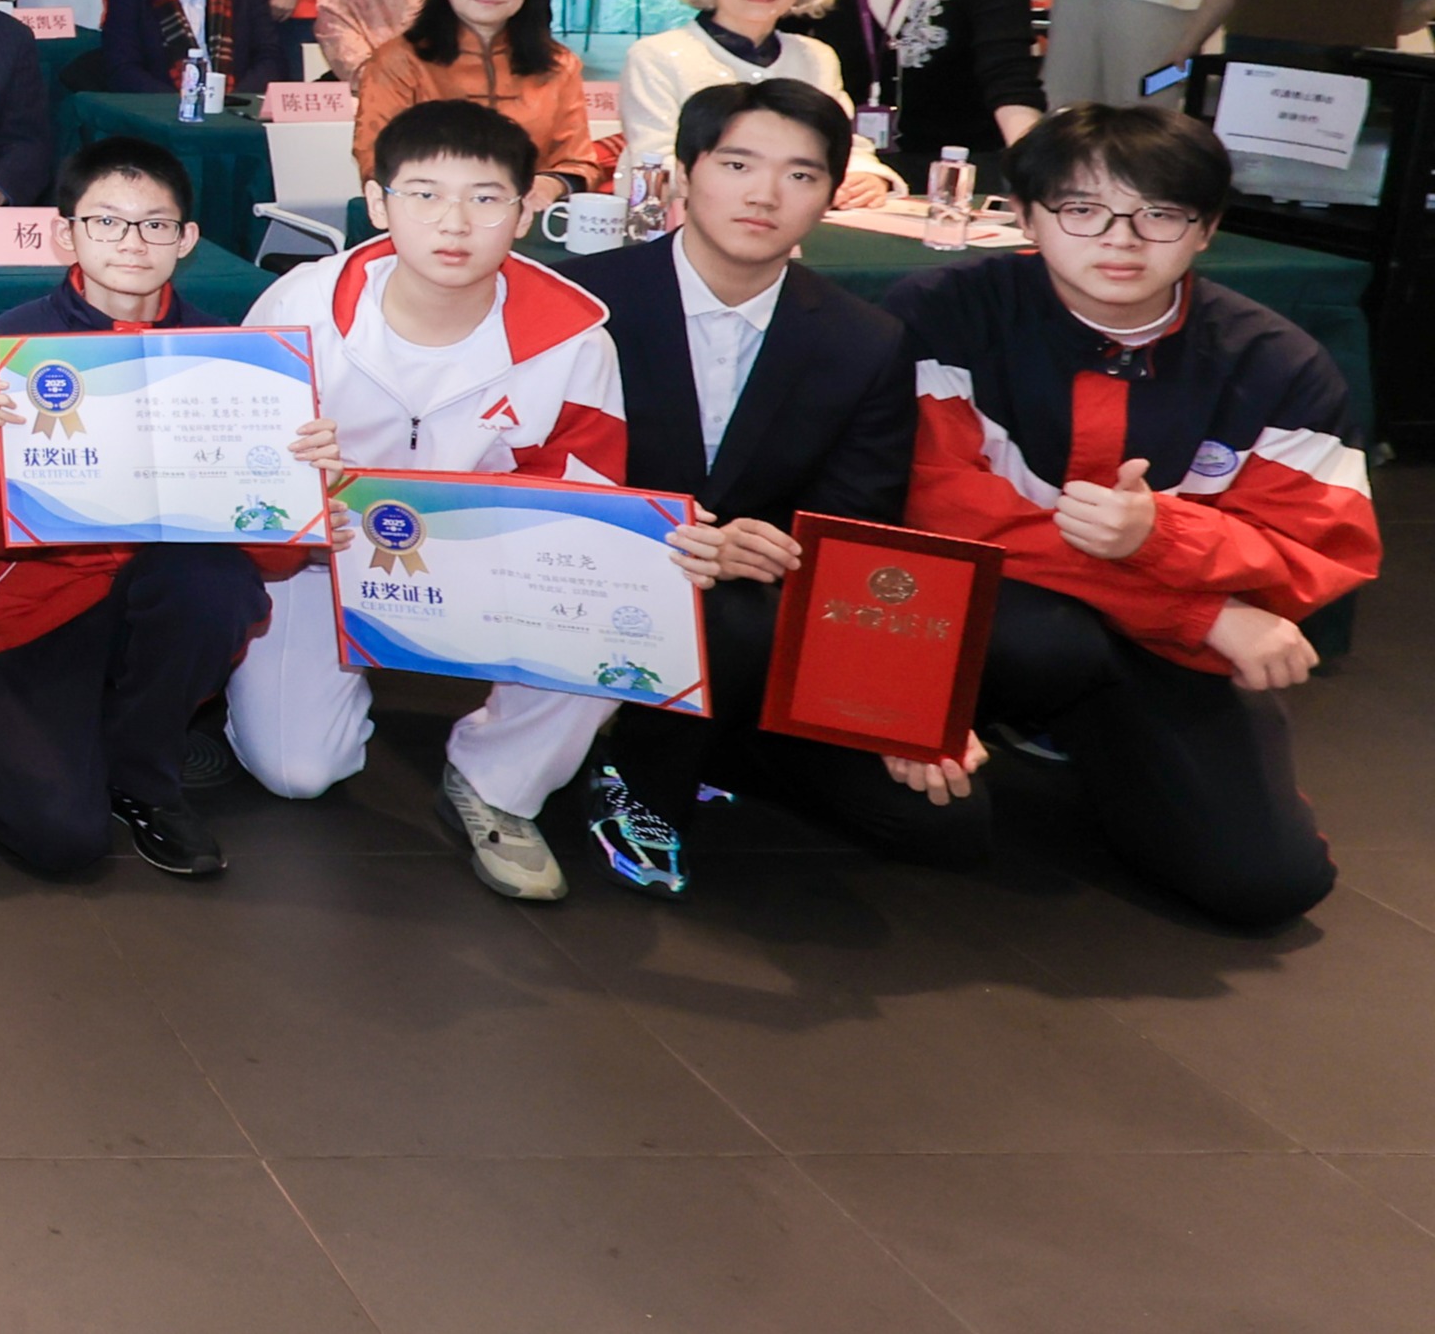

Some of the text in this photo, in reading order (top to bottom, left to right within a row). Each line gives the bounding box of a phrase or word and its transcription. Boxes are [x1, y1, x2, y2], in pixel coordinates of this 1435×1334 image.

[281, 93, 345, 112] 陈吕军
[13, 222, 42, 249] 杨
[23, 447, 99, 466] 获奖证书
[23, 468, 101, 479] CERTIFICATE
[361, 580, 443, 605] 获奖证书
[360, 600, 446, 618] CERTIFICATE
